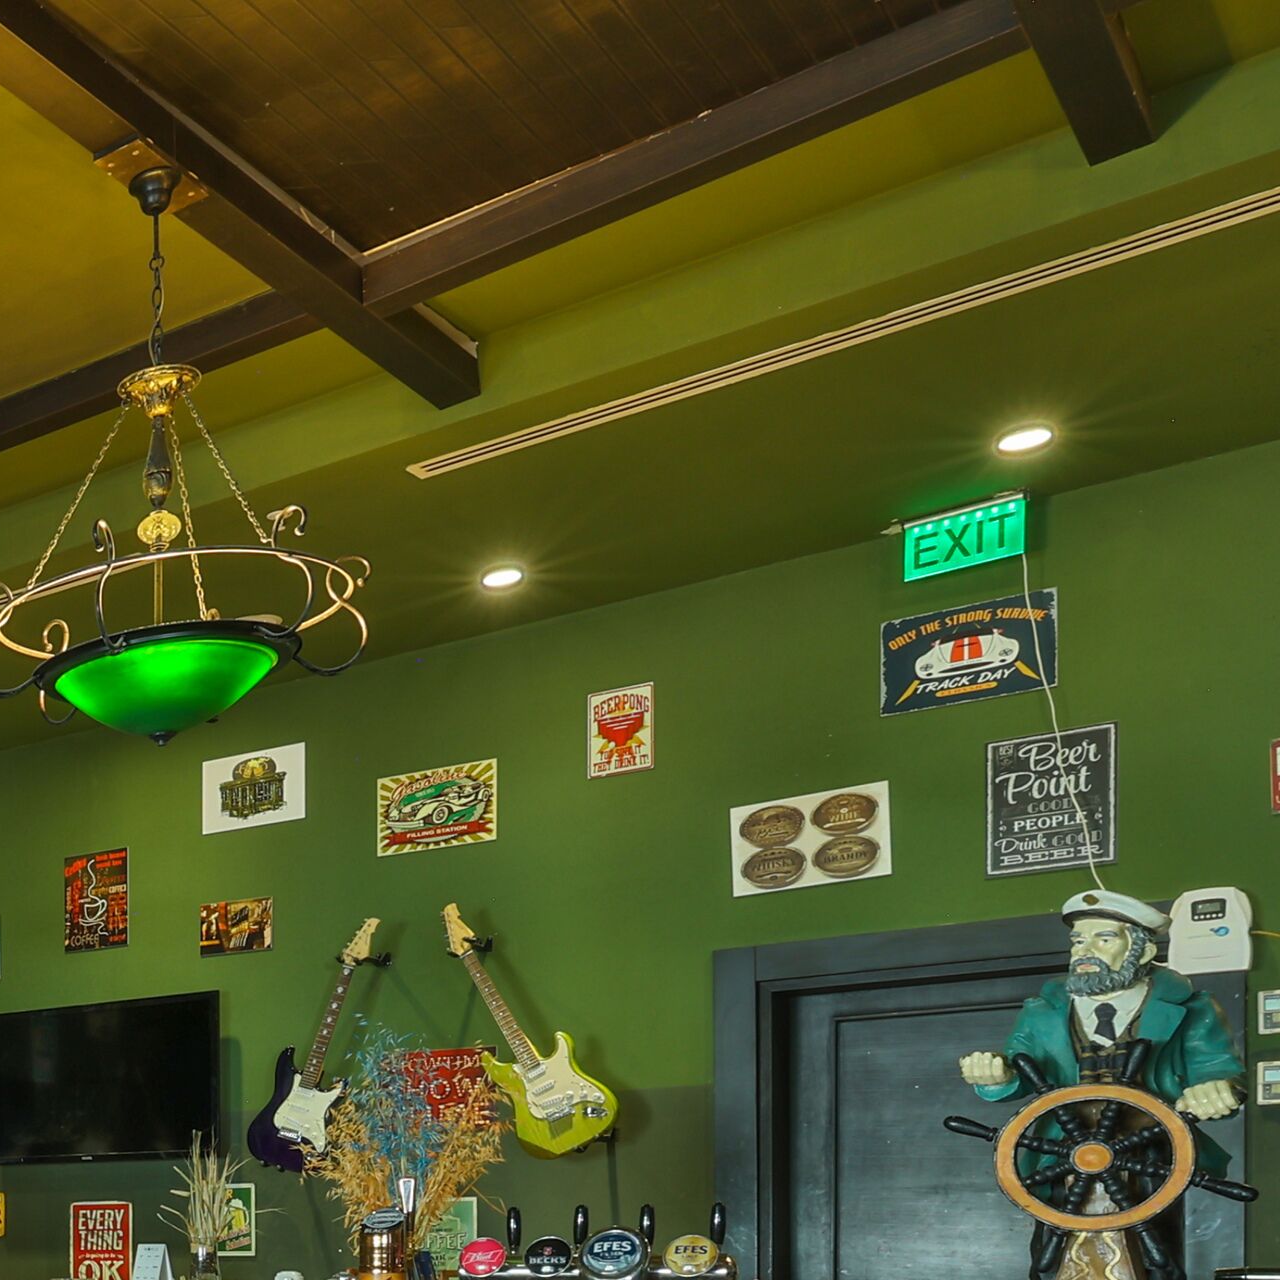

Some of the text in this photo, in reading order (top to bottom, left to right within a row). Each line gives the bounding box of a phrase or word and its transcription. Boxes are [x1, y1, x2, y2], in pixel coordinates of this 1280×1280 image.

[913, 511, 1016, 570] EXIT
[888, 631, 917, 651] ONLY
[921, 621, 943, 636] THE
[945, 609, 992, 629] STRONG
[916, 674, 970, 694] TRACK
[977, 666, 1017, 684] DAY
[593, 694, 650, 723] BEER PONG
[1018, 739, 1102, 771] Beer
[391, 769, 467, 801] Gasoline
[995, 765, 1092, 804] Point
[1027, 798, 1074, 814] GOOD
[406, 825, 468, 839] FILLING STATION
[1013, 811, 1088, 832] PEOPLE
[994, 834, 1048, 853] Drink
[823, 851, 868, 864] BRANDY
[1000, 845, 1104, 866] BEER
[78, 1209, 125, 1230] EVERY
[78, 1230, 124, 1251] THING
[593, 1241, 632, 1253] EFES
[673, 1245, 709, 1255] EFES
[529, 1255, 567, 1265] BECK'S
